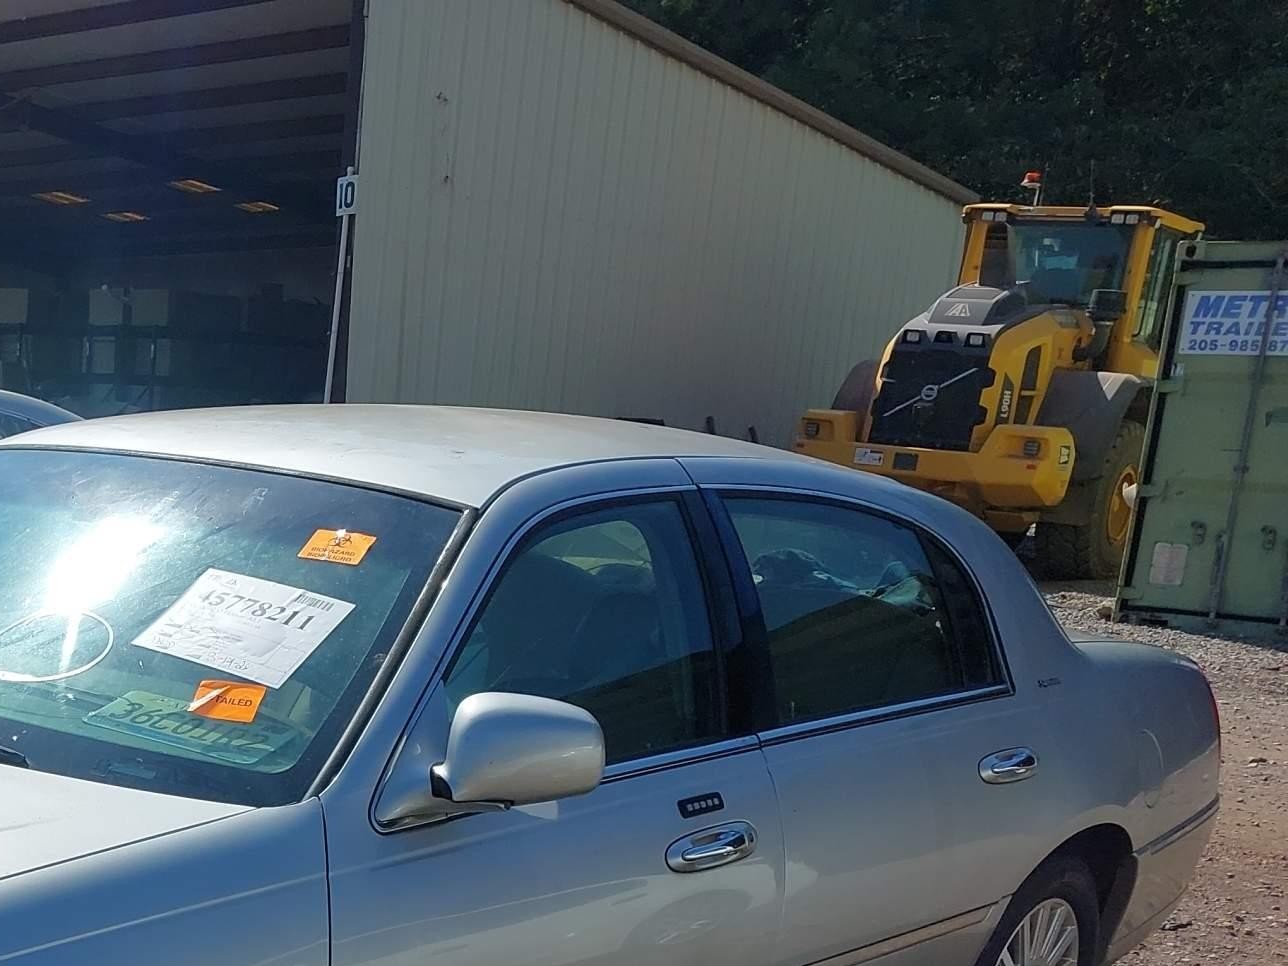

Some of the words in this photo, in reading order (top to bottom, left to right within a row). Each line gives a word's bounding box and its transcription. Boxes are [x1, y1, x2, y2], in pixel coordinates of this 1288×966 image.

[338, 181, 355, 209] 10
[1188, 339, 1288, 352] 205-98587
[199, 589, 315, 631] 45778211
[214, 694, 253, 708] TAILED
